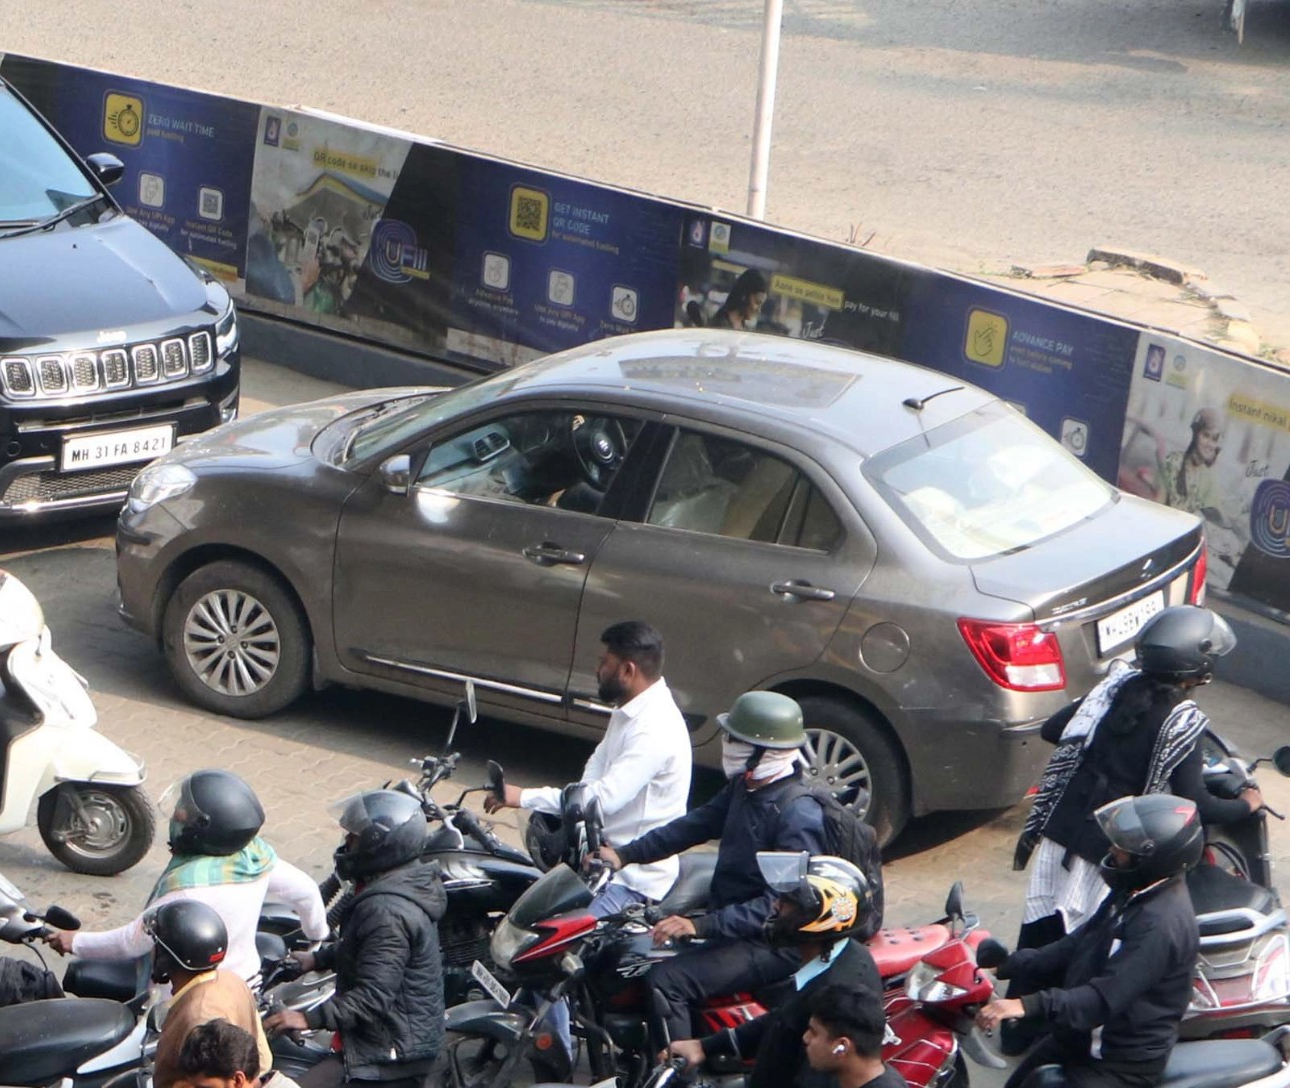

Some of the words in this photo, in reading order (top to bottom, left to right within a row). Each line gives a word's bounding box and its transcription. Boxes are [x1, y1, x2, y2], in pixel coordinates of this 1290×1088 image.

[148, 114, 170, 127] ZERO
[171, 118, 194, 133] WAIT
[194, 123, 216, 138] TIME
[314, 151, 326, 164] QR
[378, 168, 391, 179] the
[553, 216, 567, 229] QR
[554, 202, 571, 215] GET
[573, 205, 609, 224] INSTANT
[1012, 331, 1053, 352] ADVANCE
[1056, 342, 1074, 357] PAY
[1229, 399, 1263, 417] Instant
[71, 448, 90, 462] MH
[95, 446, 108, 459] 31
[133, 437, 165, 453] 8421
